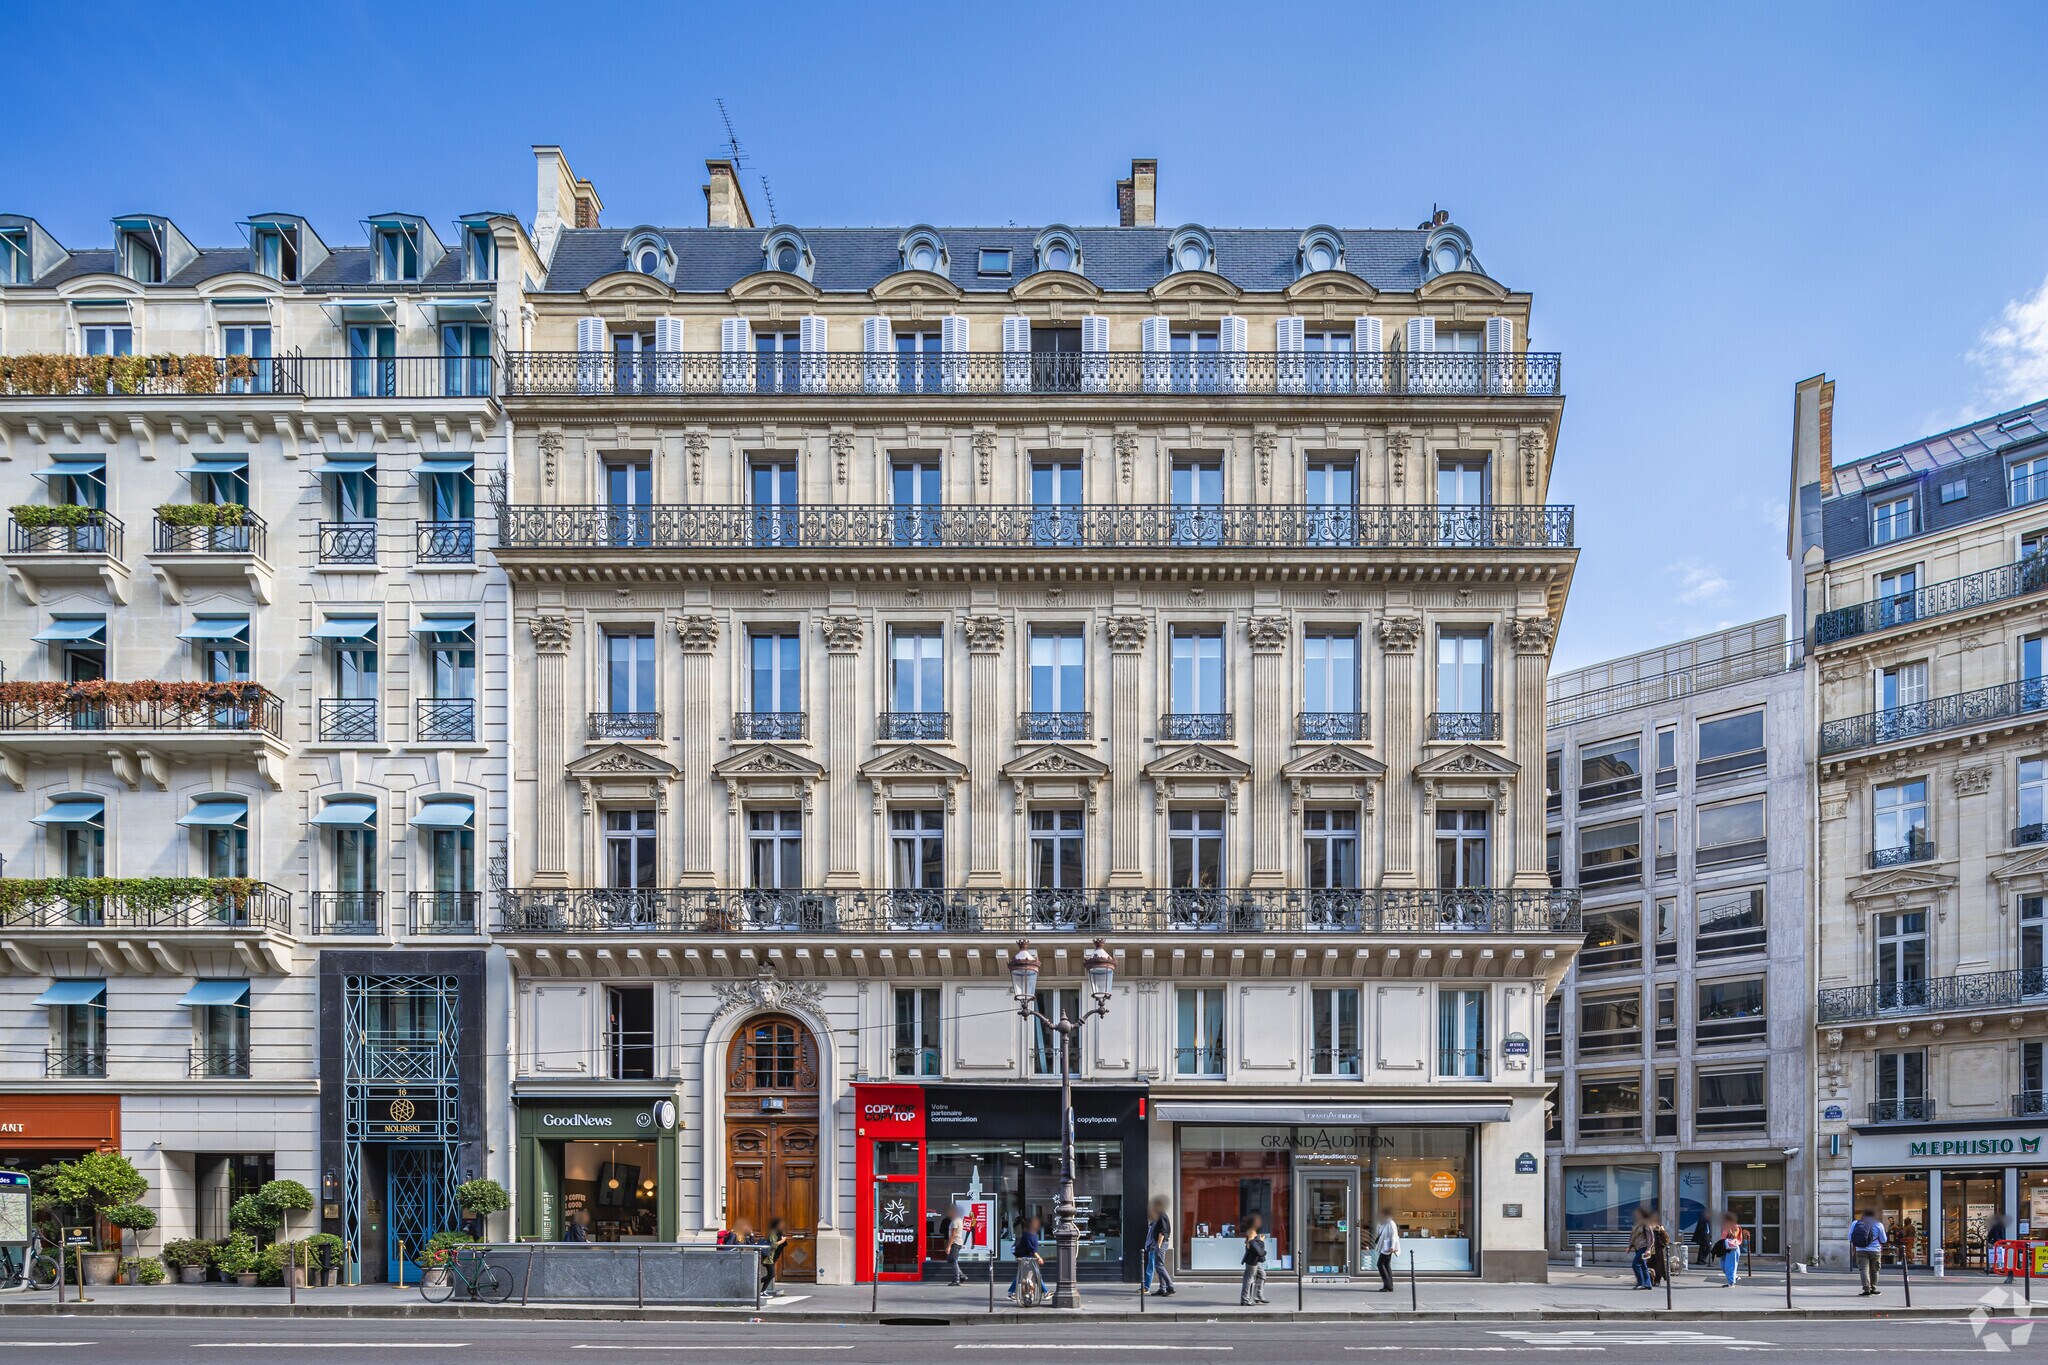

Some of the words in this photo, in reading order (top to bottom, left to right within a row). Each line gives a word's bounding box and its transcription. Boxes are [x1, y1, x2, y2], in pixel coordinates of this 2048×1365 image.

[543, 1113, 612, 1126] GoodNews
[1077, 1116, 1117, 1124] copytop.com
[1, 1123, 24, 1132] ANT
[384, 1125, 420, 1133] NOLINSKI
[1911, 1139, 2013, 1155] MEPHISTO
[877, 1233, 914, 1244] Unique
